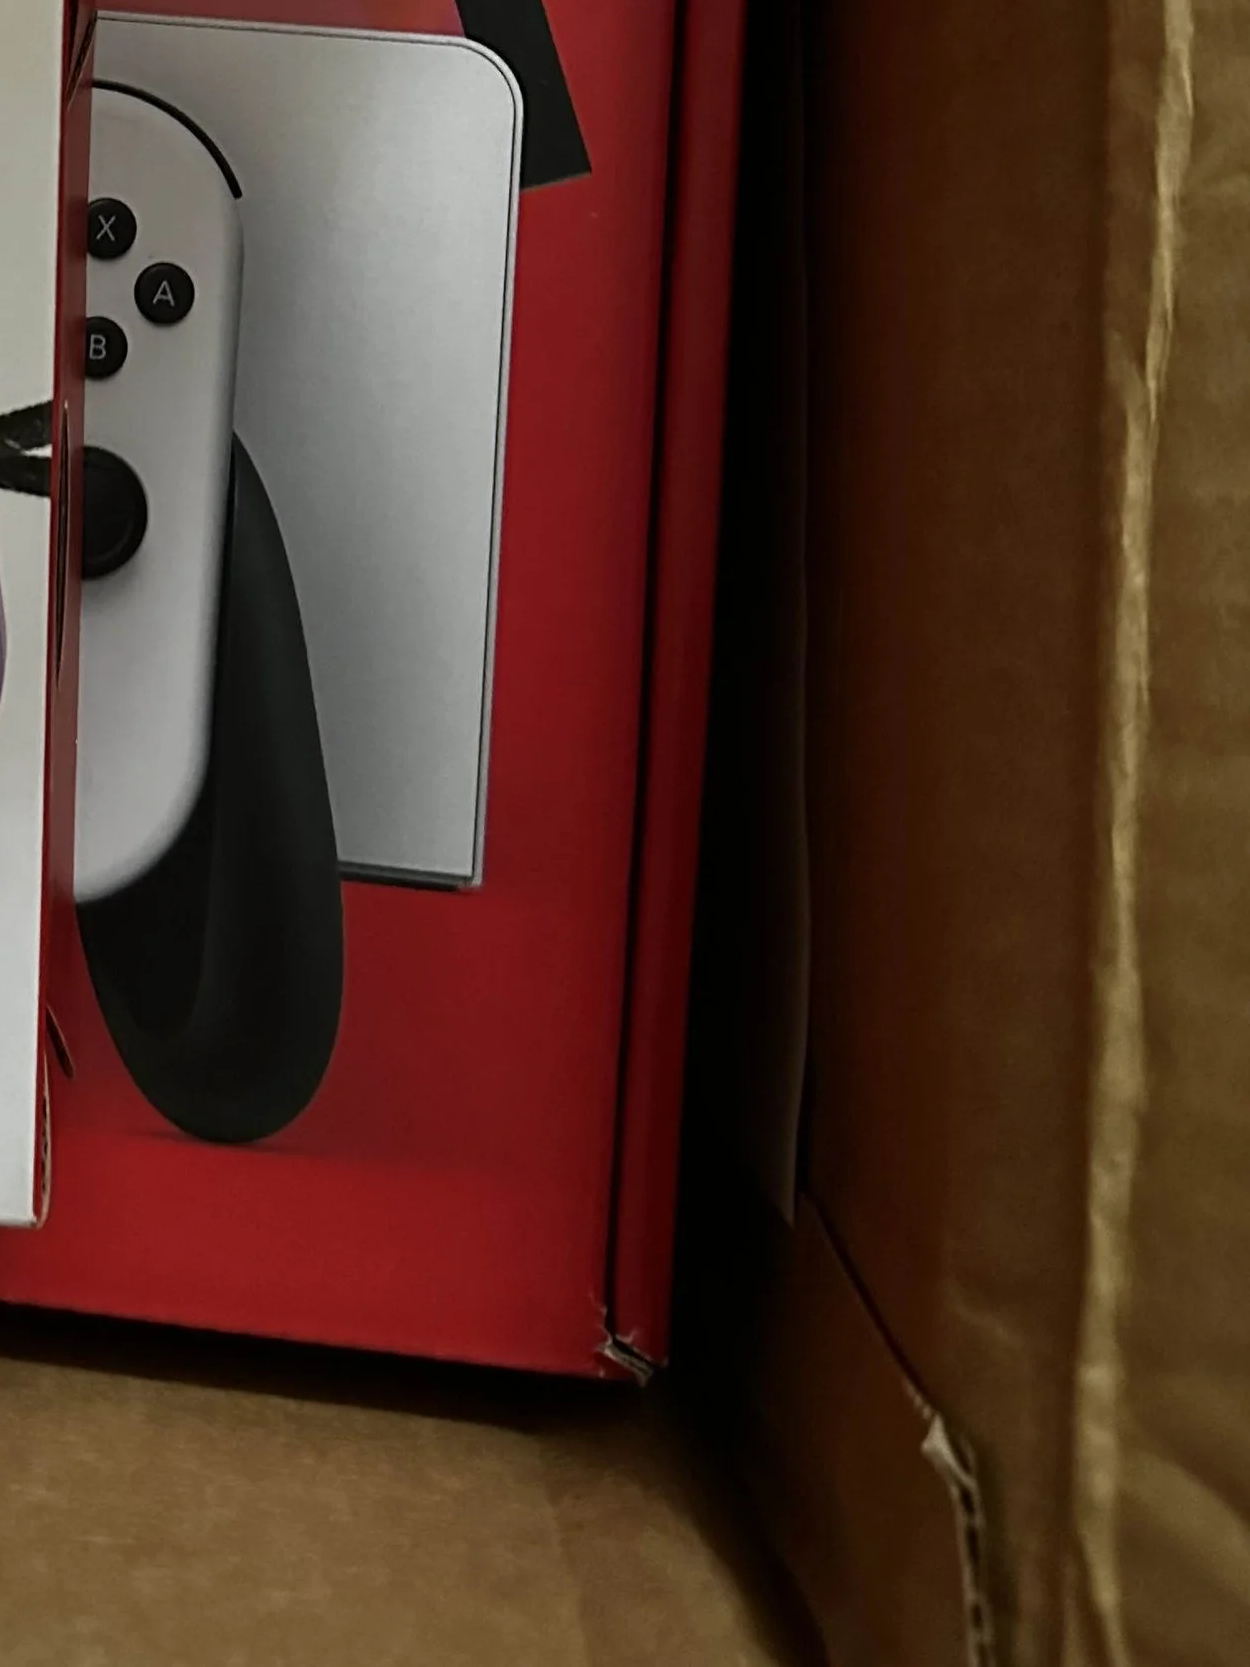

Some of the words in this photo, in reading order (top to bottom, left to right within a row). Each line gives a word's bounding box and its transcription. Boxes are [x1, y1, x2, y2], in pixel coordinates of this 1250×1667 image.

[95, 214, 117, 241] X
[152, 281, 175, 307] A
[88, 335, 107, 359] B
